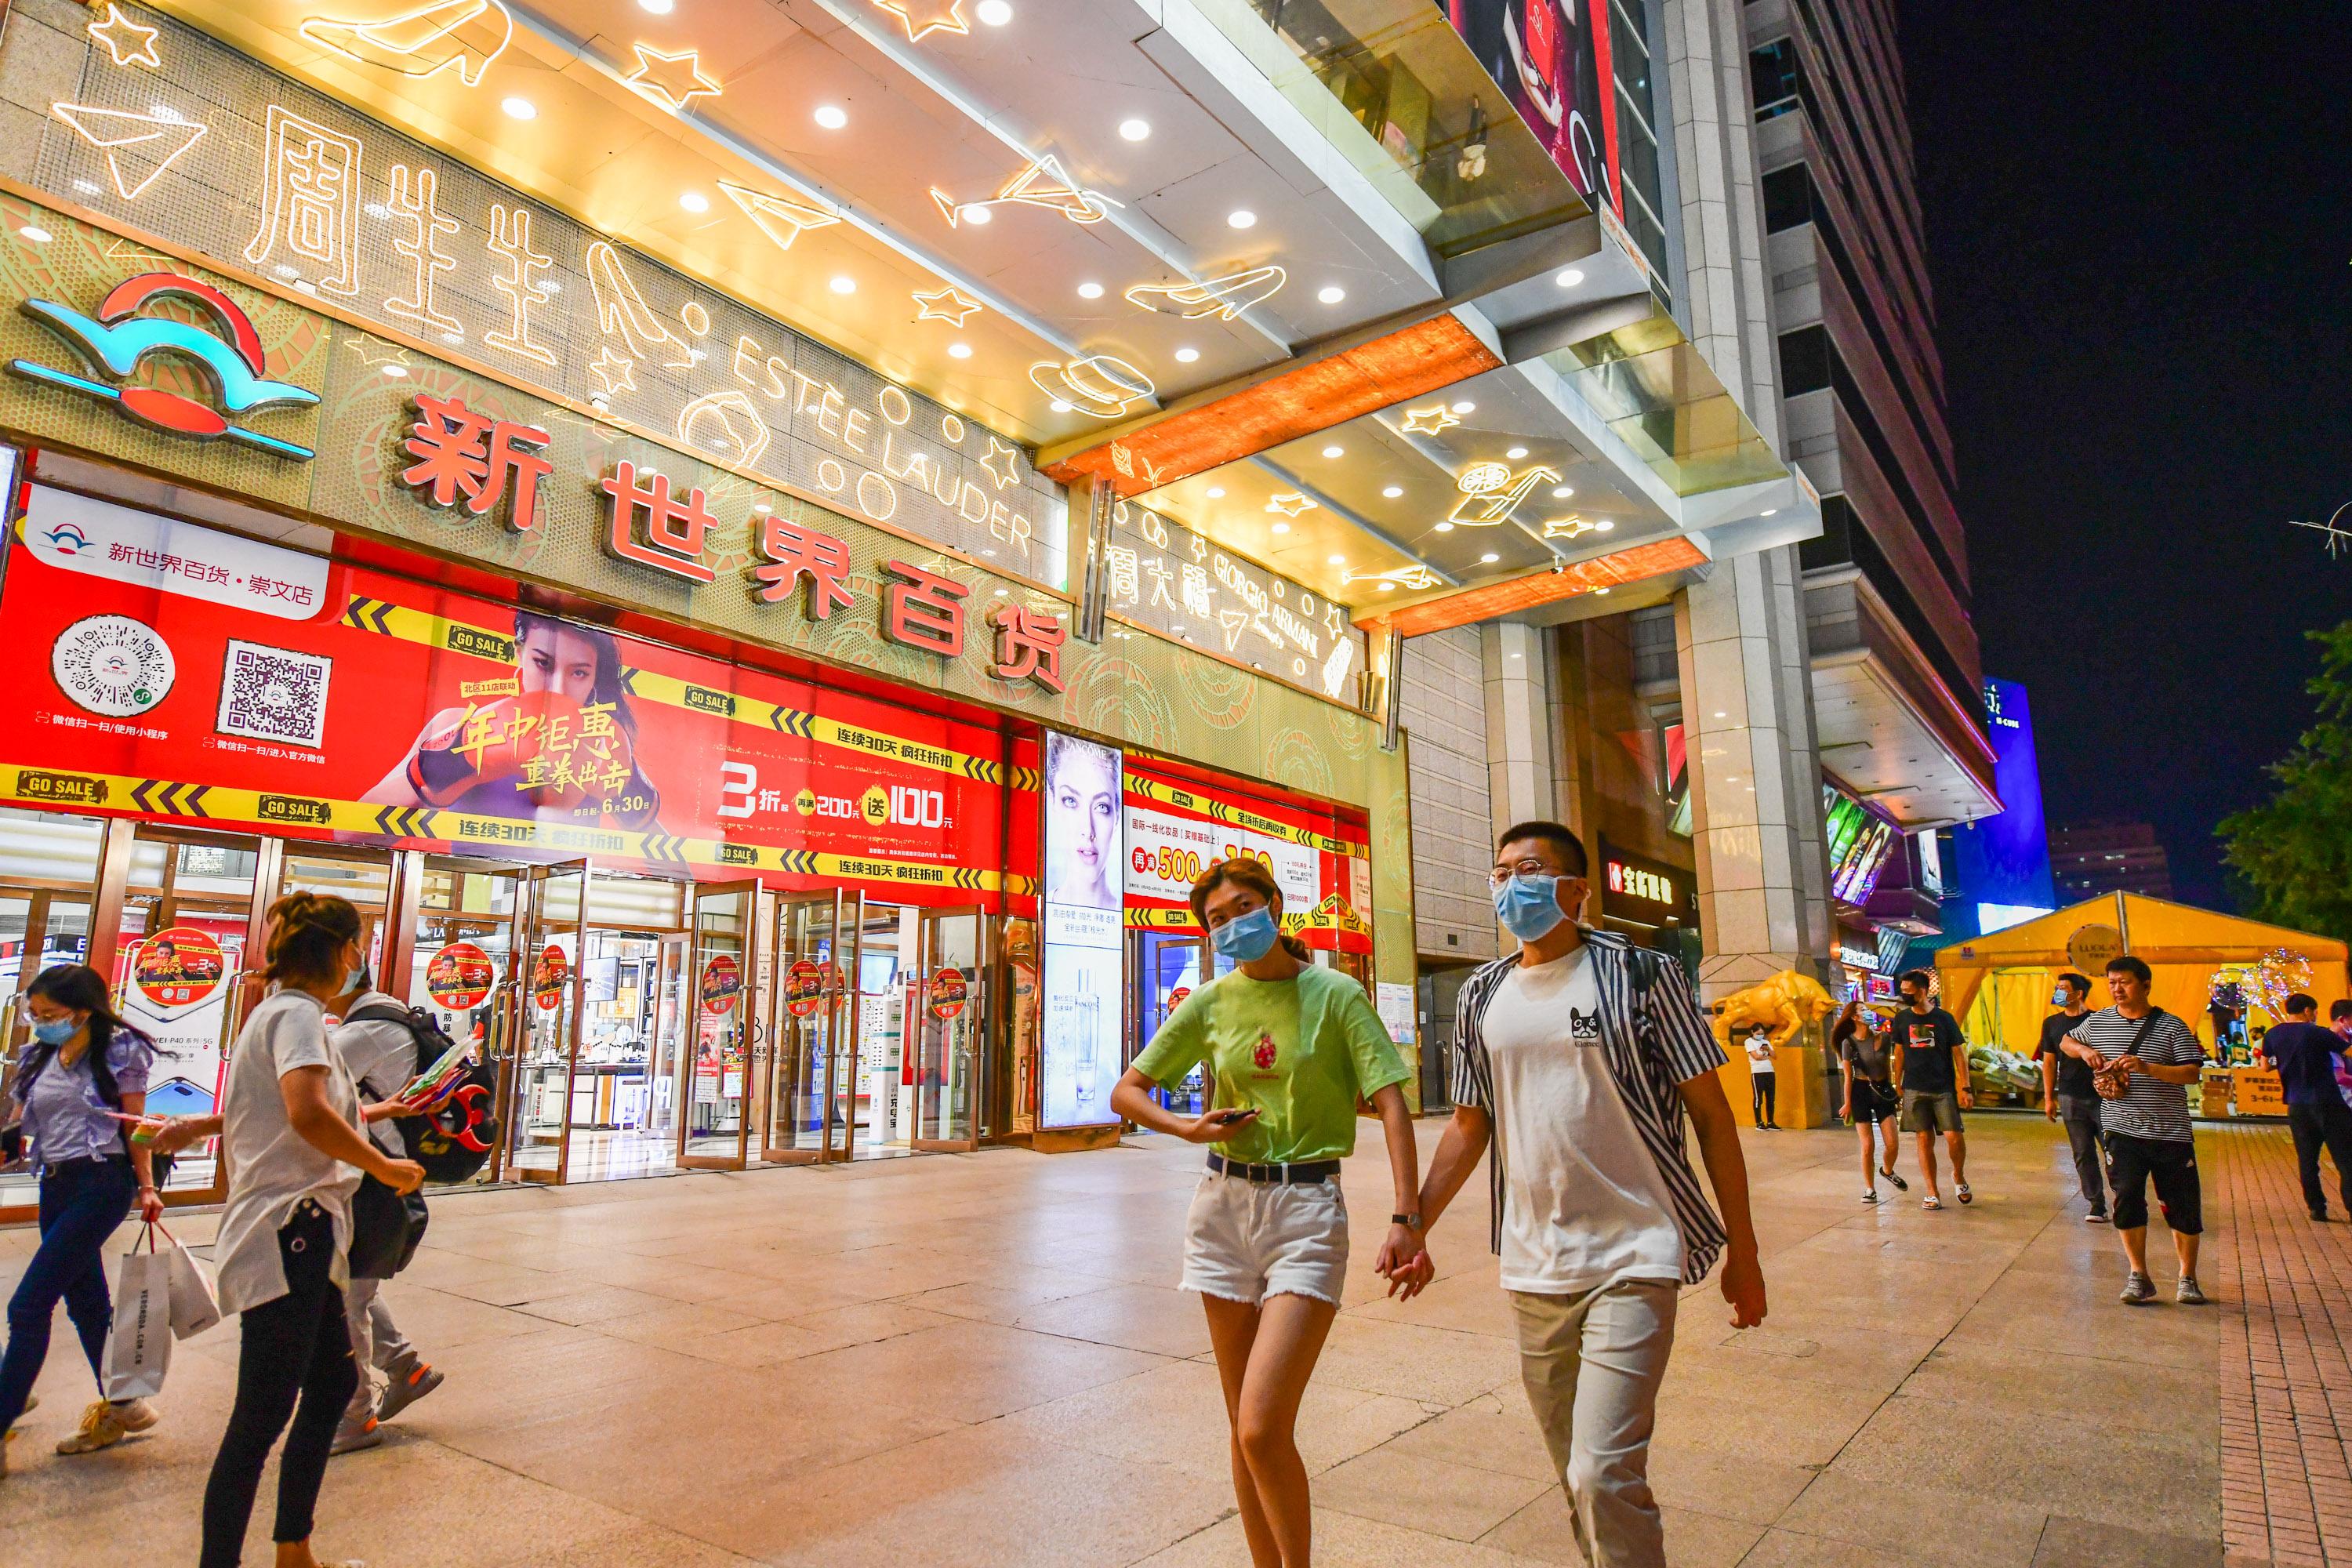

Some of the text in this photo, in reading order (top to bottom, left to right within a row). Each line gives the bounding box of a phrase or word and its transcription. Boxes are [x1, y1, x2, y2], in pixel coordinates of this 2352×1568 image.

[244, 103, 557, 366] 周生生
[883, 432, 1032, 557] LAUDER
[400, 392, 1065, 695] 新世界百货
[1110, 546, 1210, 619] 周大福
[1214, 553, 1319, 659] GIORGIO ARMANI
[456, 632, 505, 655] GO SALE
[463, 681, 517, 694] 北区11店联动
[691, 691, 728, 710] GO SALE
[52, 713, 169, 742] 微信扫一扫/使用小程序
[451, 700, 622, 777] 年中钜惠
[216, 739, 326, 765] 微信扫一扫/进入官方微信
[837, 727, 953, 769] 连续30天 疯狂折扣
[28, 777, 94, 797] GO SALE
[516, 753, 632, 795] 重拳出击
[267, 800, 320, 818] GO SALE
[868, 797, 885, 818] 送
[459, 819, 624, 851] 连续30天 疯狂折扣
[1237, 811, 1287, 837] 全场折后再收券
[733, 848, 752, 862] SALE
[1157, 846, 1200, 885] 500
[838, 859, 944, 883] 连续30天 疯狂折扣
